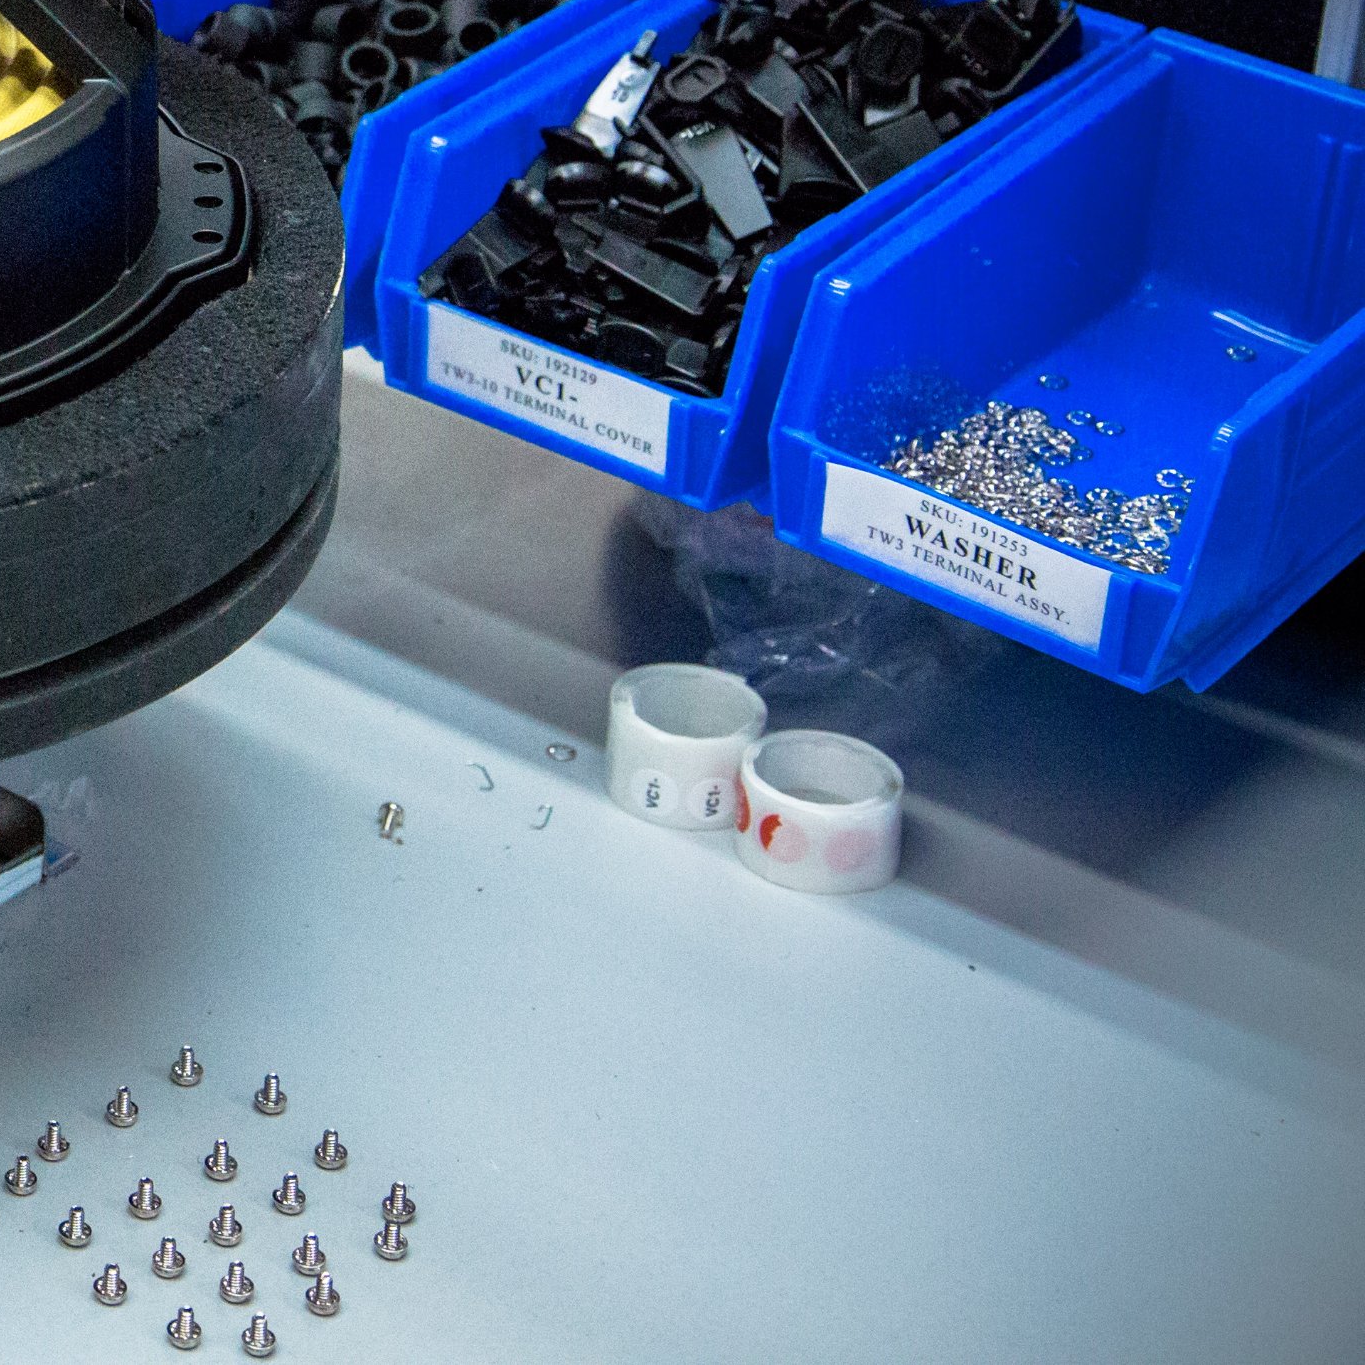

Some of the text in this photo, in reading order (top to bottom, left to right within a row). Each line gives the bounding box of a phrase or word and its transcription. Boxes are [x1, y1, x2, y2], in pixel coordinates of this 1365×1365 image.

[499, 338, 598, 385] SKU: 192129
[504, 386, 589, 431] TERMINAL
[595, 423, 653, 455] COVER
[905, 514, 1038, 591] WASHER
[920, 499, 1028, 556] SKU: 191253
[867, 525, 1070, 625] TW3 TERMINAL ASSY.
